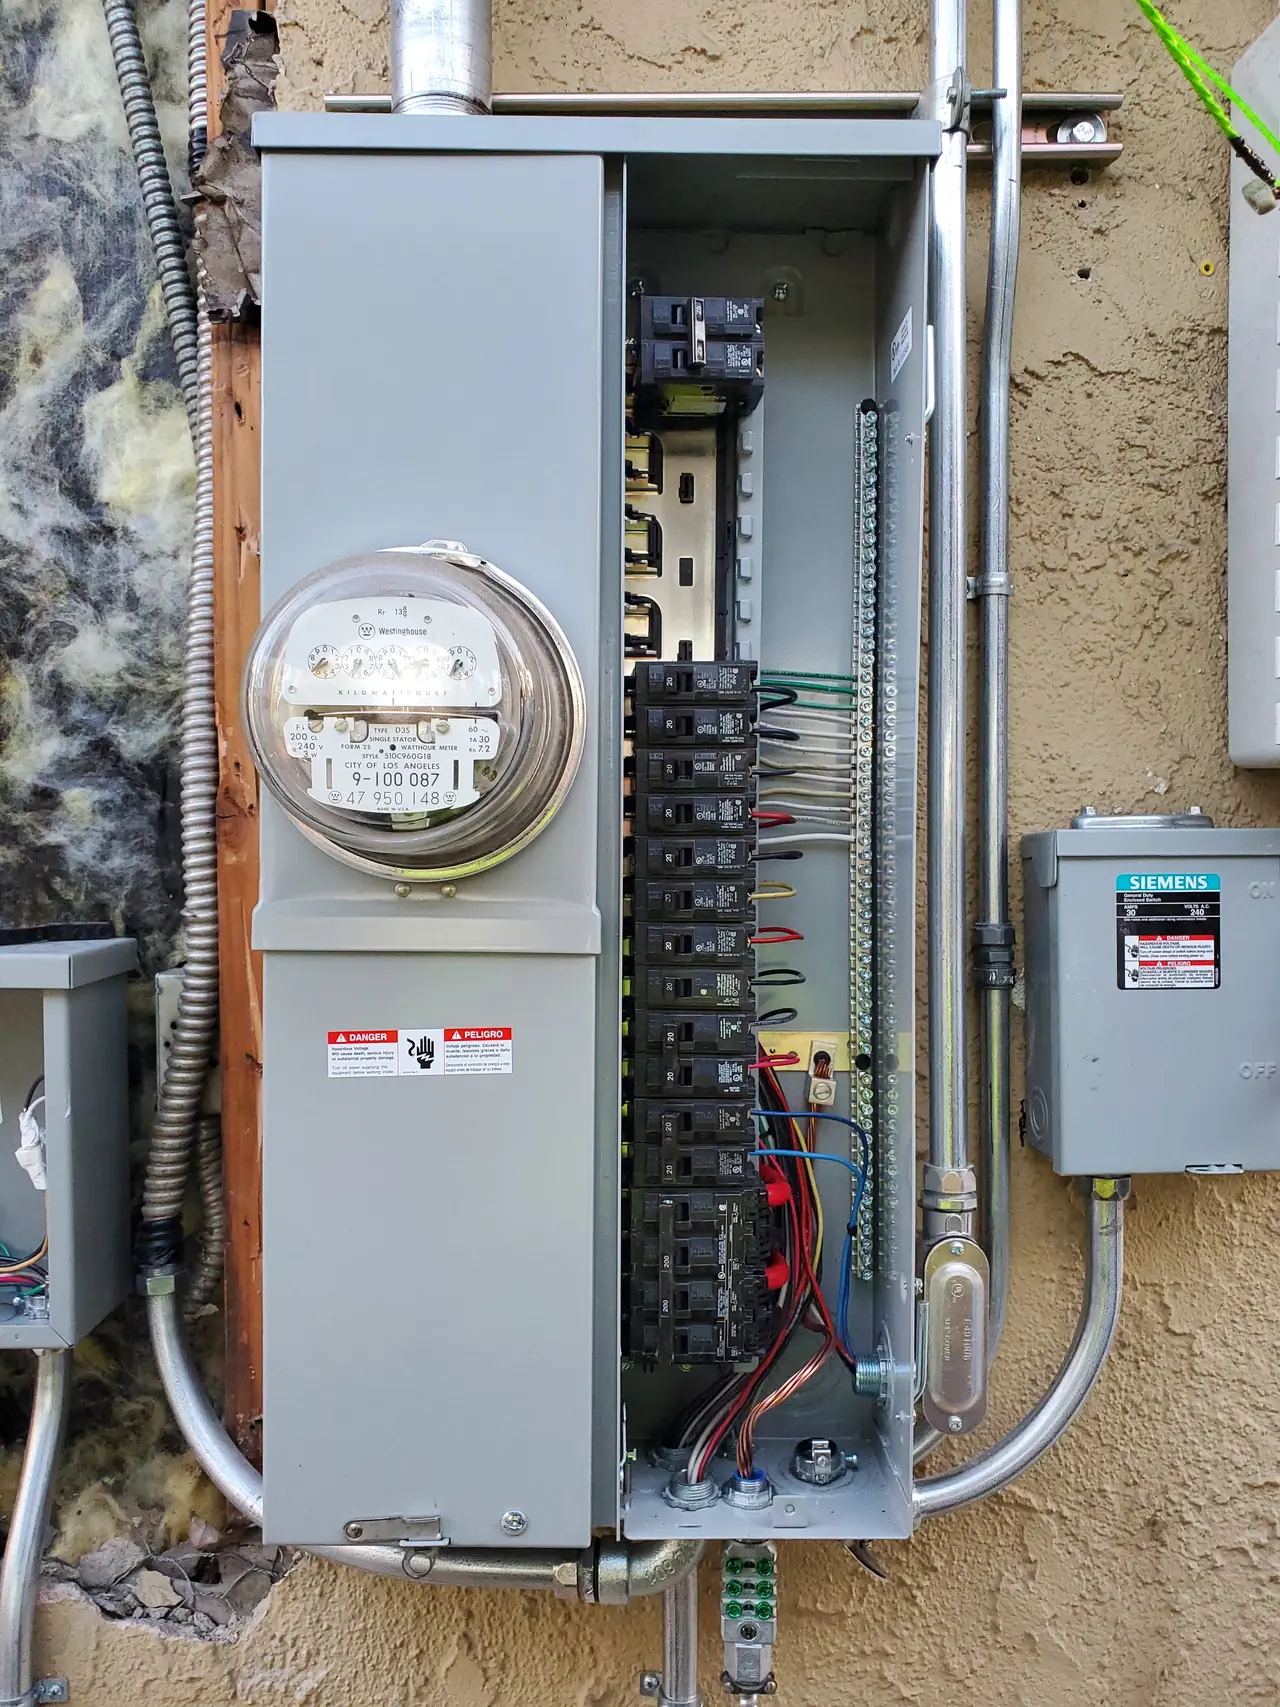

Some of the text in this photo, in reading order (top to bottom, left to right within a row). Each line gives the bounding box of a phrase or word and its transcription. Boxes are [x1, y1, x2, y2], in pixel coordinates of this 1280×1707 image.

[379, 628, 427, 636] Westinghouse
[667, 678, 672, 686] 20
[667, 720, 673, 728] 20
[667, 764, 672, 773] 20
[352, 772, 439, 787] 9-100 087
[346, 792, 439, 805] 47 950 148
[666, 809, 672, 817] 20
[666, 854, 672, 863] 20
[1130, 876, 1207, 889] SIEMENS
[1249, 881, 1275, 899] ON
[665, 894, 671, 902] 20
[666, 942, 672, 950] 20
[667, 983, 672, 991] 20
[668, 1032, 674, 1041] 20
[1239, 1061, 1276, 1079] OFF
[667, 1072, 674, 1081] 20
[665, 1122, 672, 1132] 20
[666, 1165, 672, 1174] 20
